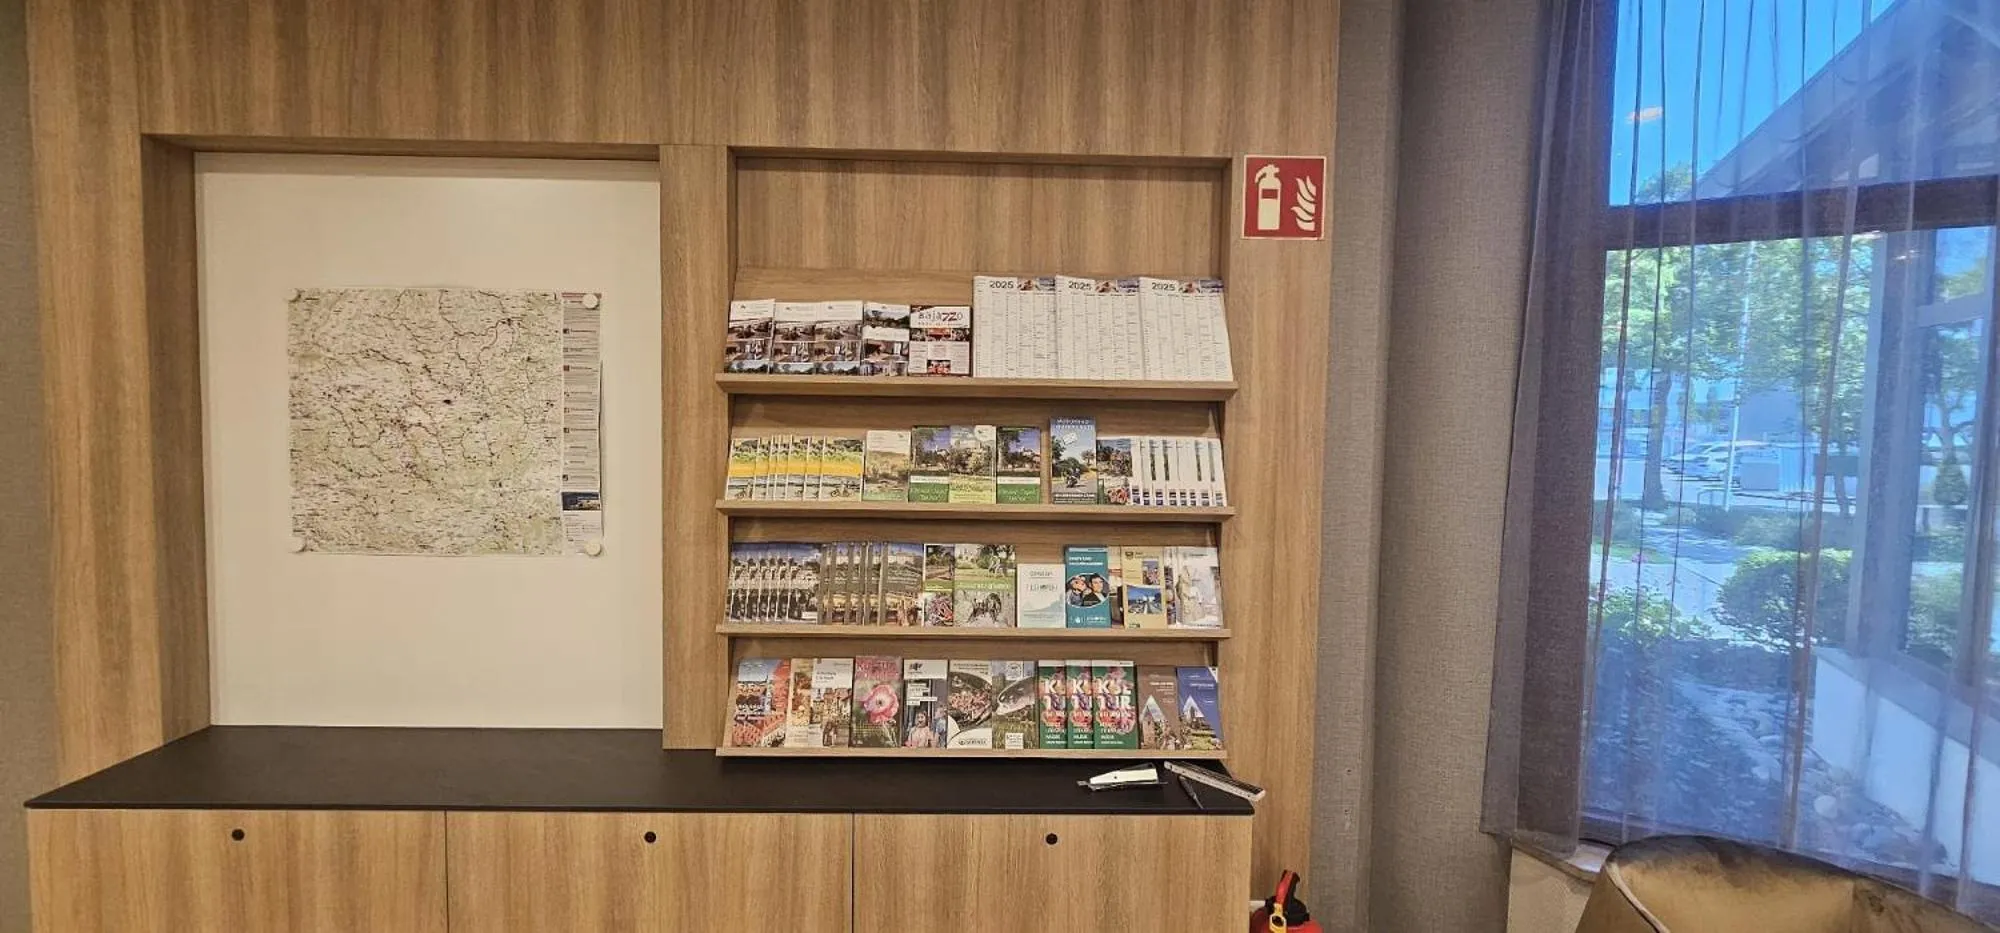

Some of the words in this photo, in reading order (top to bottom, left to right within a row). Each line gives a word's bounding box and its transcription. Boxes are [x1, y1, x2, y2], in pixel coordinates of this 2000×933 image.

[989, 280, 1015, 289] 2025
[1068, 280, 1092, 290] 2025
[1151, 282, 1176, 292] 2025
